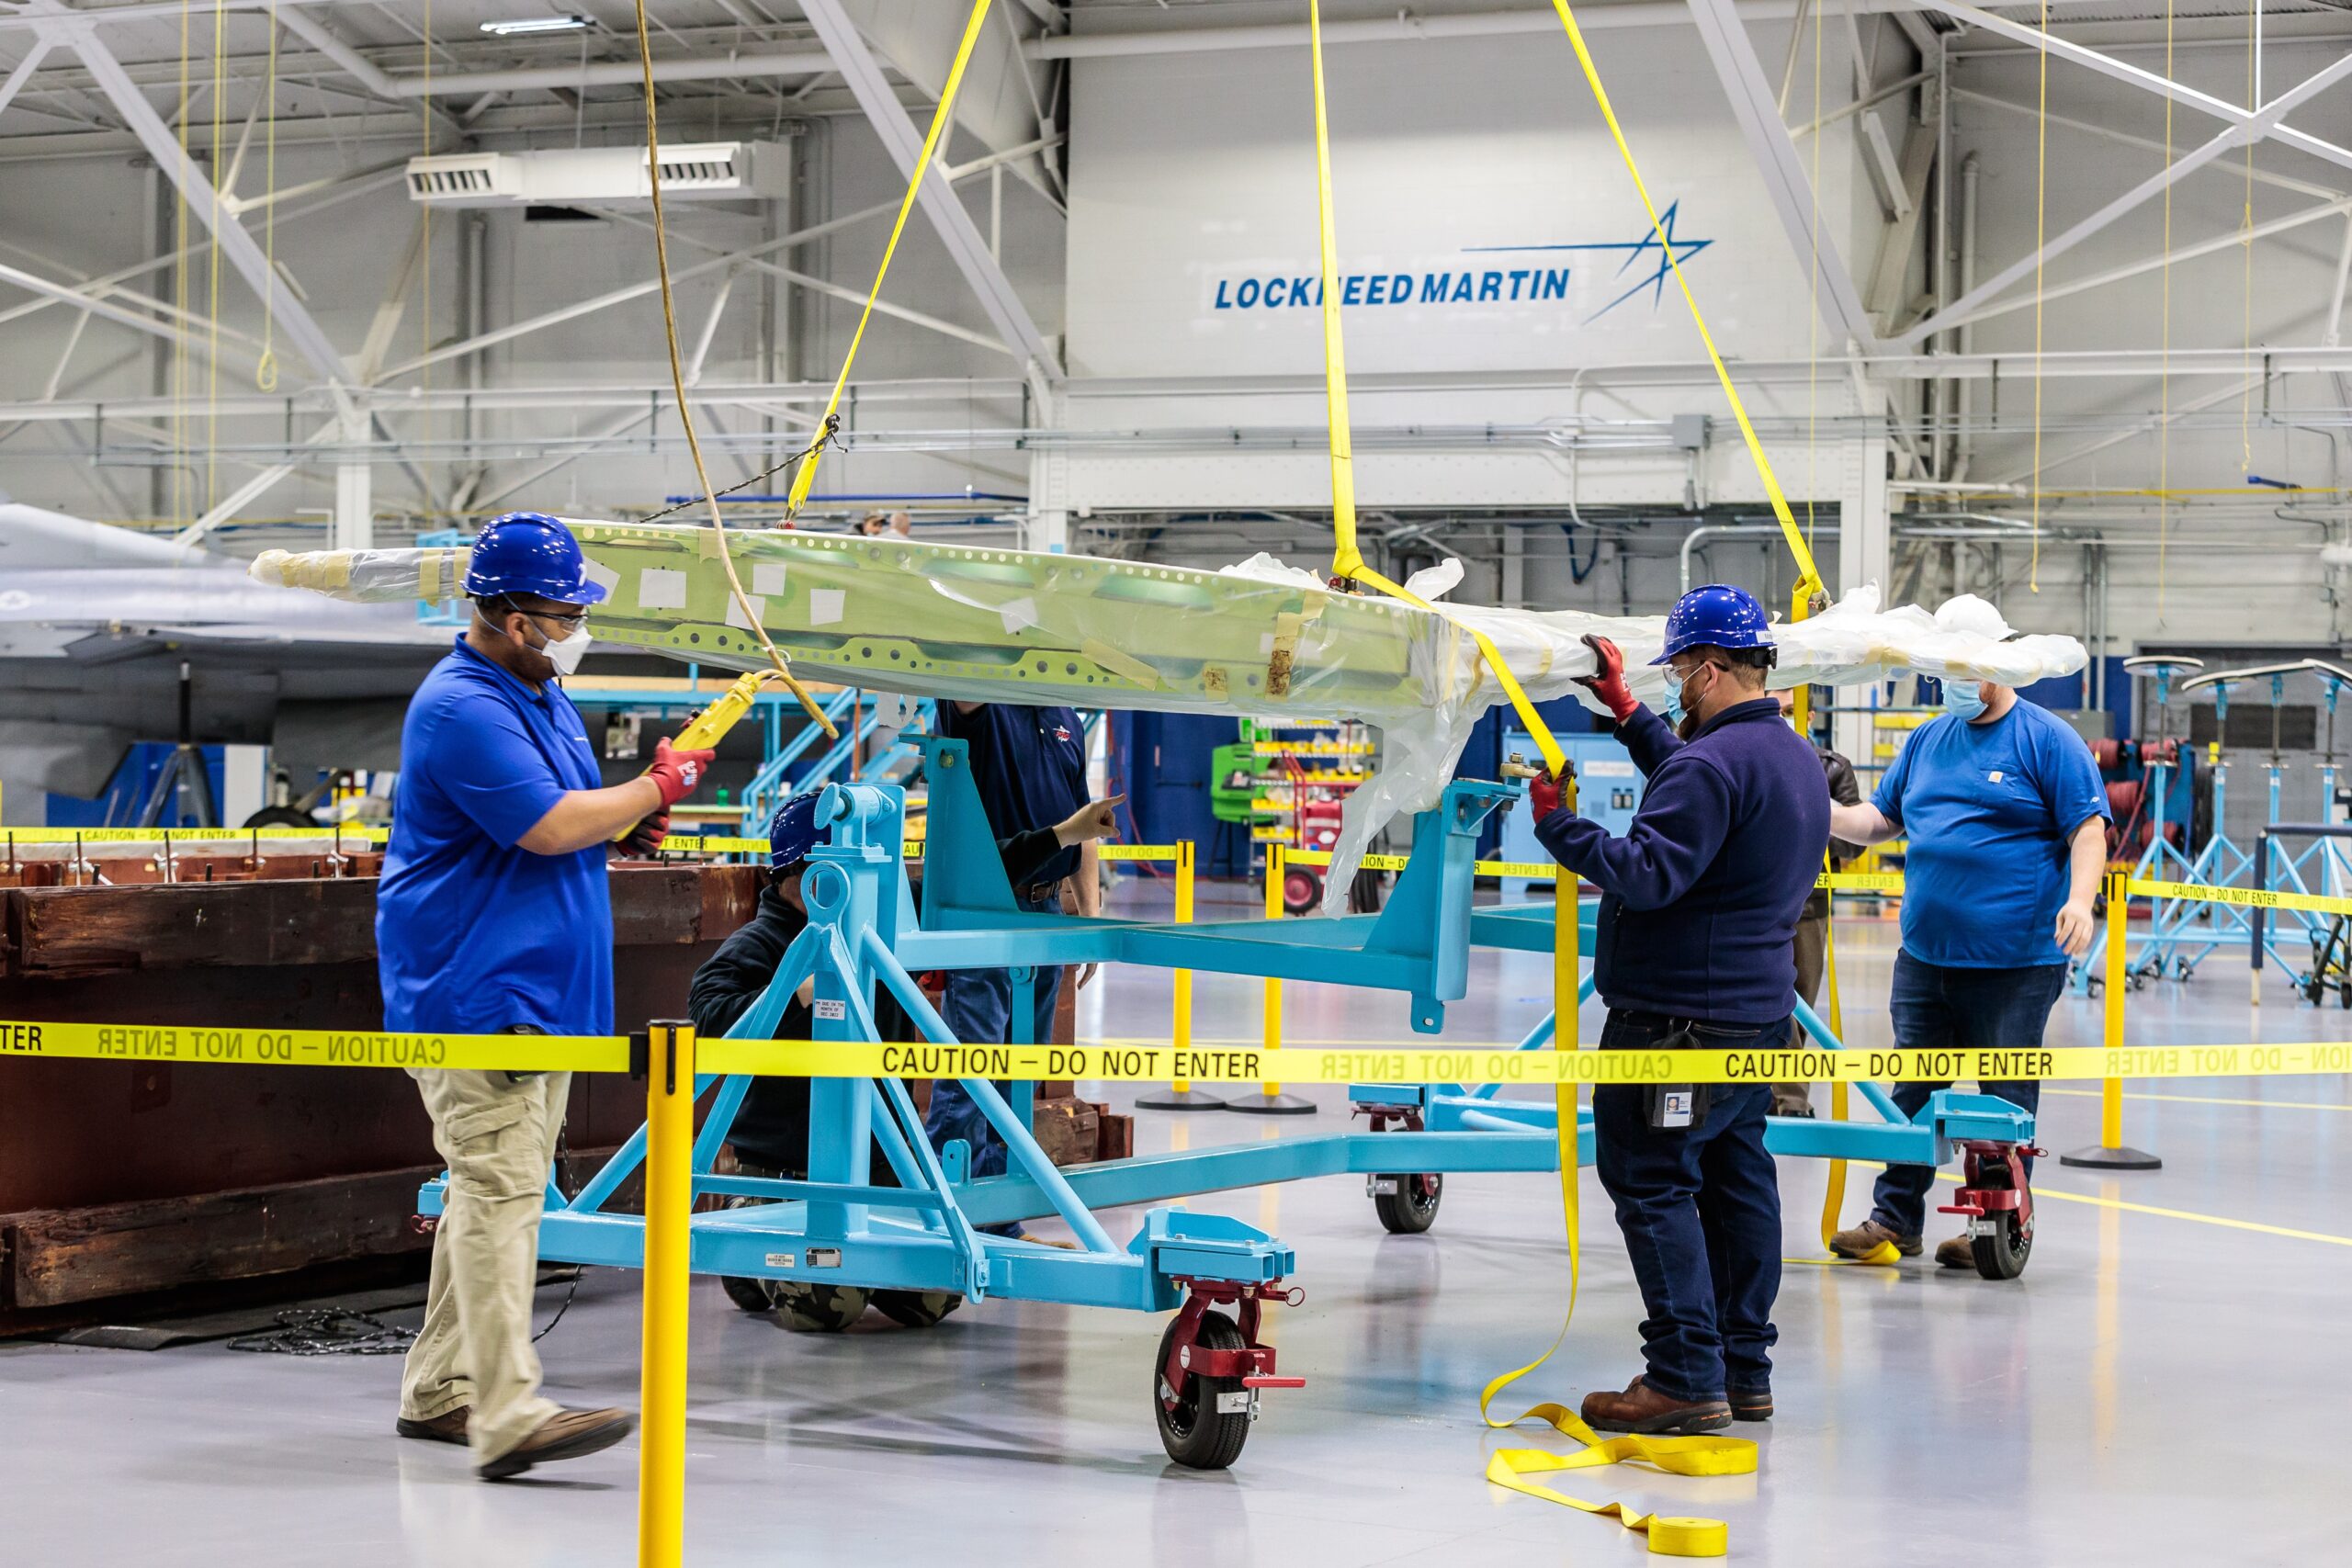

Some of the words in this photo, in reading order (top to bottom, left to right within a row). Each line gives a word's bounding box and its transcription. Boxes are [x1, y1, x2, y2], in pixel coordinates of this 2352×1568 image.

[1420, 269, 1570, 303] MARTIN
[85, 830, 135, 840] CAUTION
[150, 830, 164, 840] DO
[172, 829, 194, 840] NOT
[200, 830, 236, 840] ENTER
[2172, 884, 2207, 899] CAUTION
[2217, 889, 2228, 901] DO
[2232, 890, 2247, 902] NOT
[2252, 892, 2278, 906] ENTER
[0, 1024, 42, 1051] TER
[883, 1047, 1009, 1074] CAUTION
[1049, 1050, 1086, 1075] DO
[1102, 1052, 1159, 1077] NOT
[1174, 1053, 1260, 1078] ENTER
[1725, 1054, 1836, 1077] CAUTION
[1871, 1054, 1903, 1077] DO
[1917, 1053, 1966, 1077] NOT
[1978, 1053, 2053, 1077] ENTER
